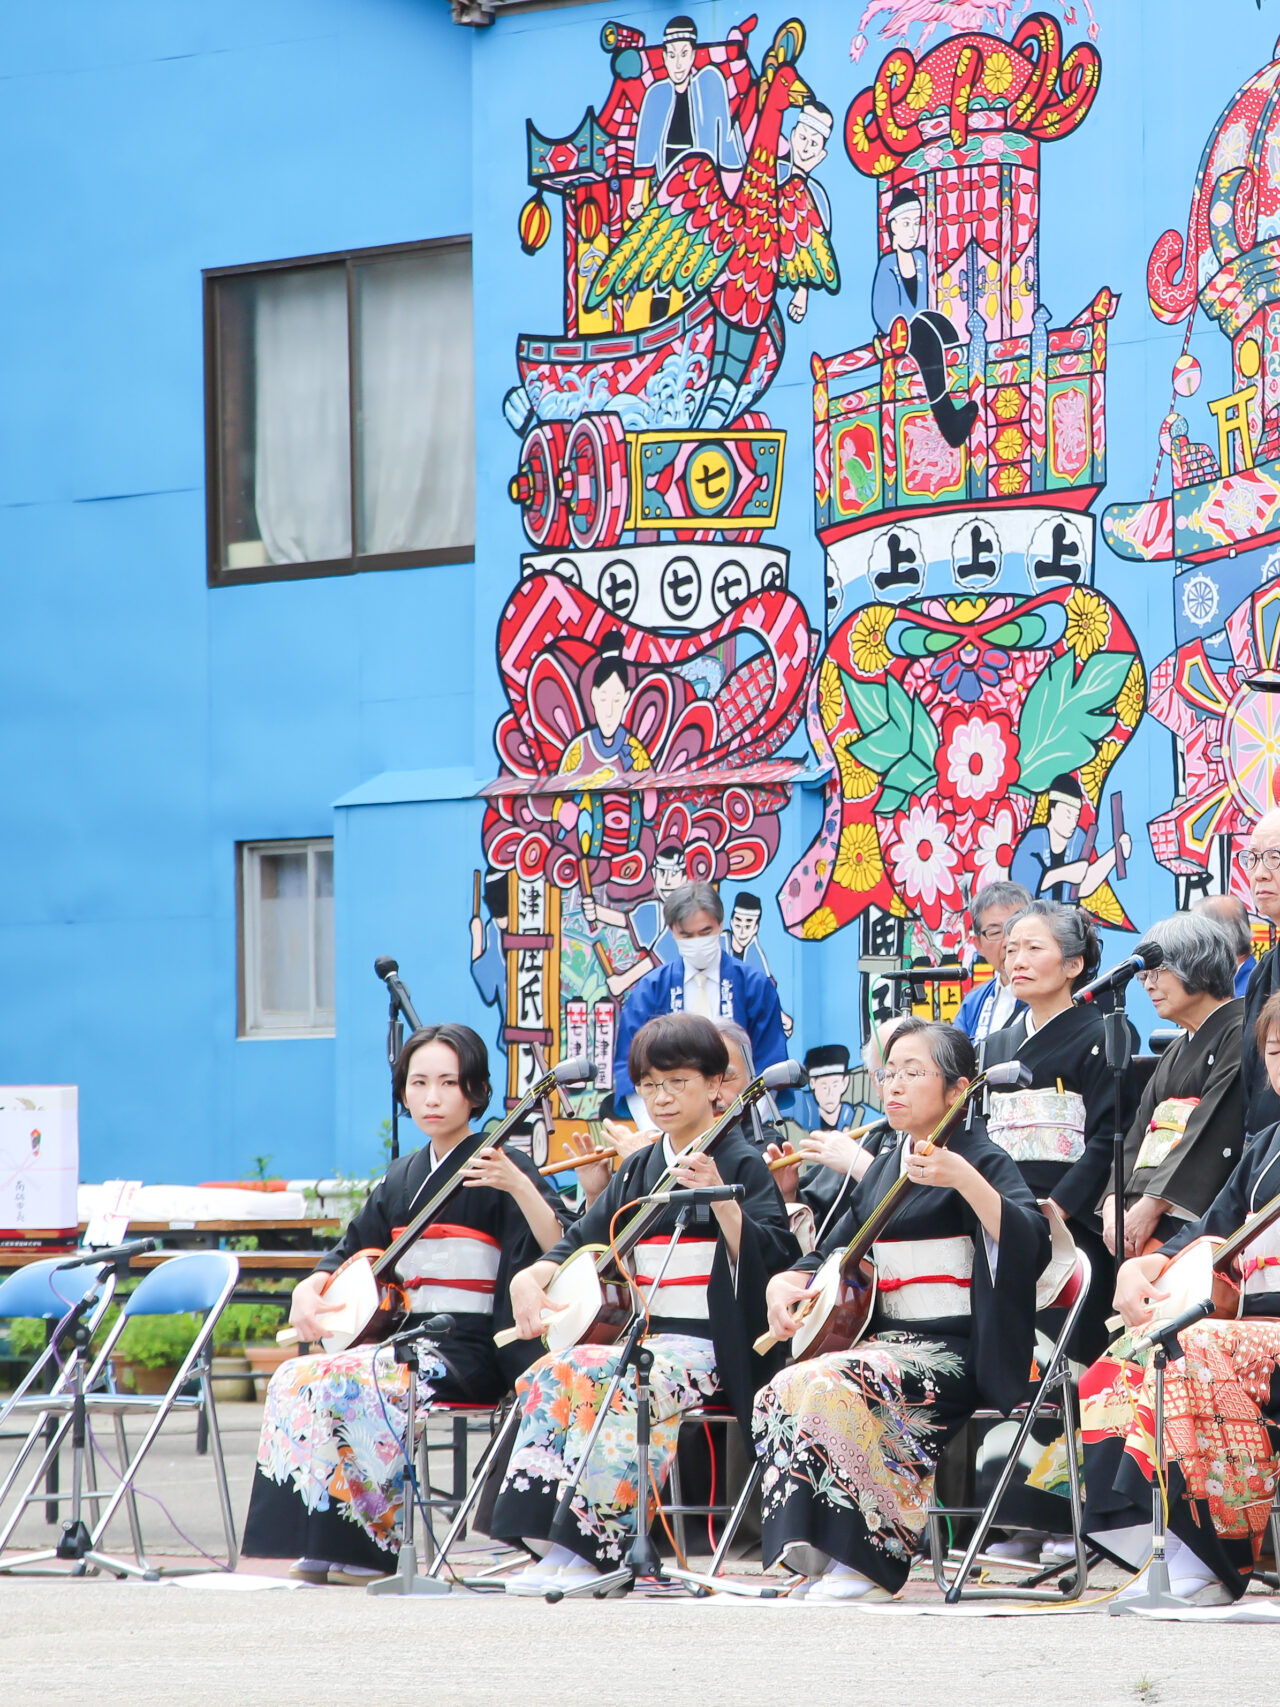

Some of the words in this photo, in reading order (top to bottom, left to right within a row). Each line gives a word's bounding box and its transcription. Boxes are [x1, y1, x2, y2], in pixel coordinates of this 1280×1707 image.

[1094, 292, 1109, 315] 上
[892, 323, 907, 349] 上
[695, 464, 726, 499] 七
[874, 533, 920, 590] 上
[957, 525, 996, 579] 上
[1034, 523, 1082, 583] 上
[605, 572, 632, 611] 七
[667, 569, 693, 606] 七
[717, 571, 742, 608] 七
